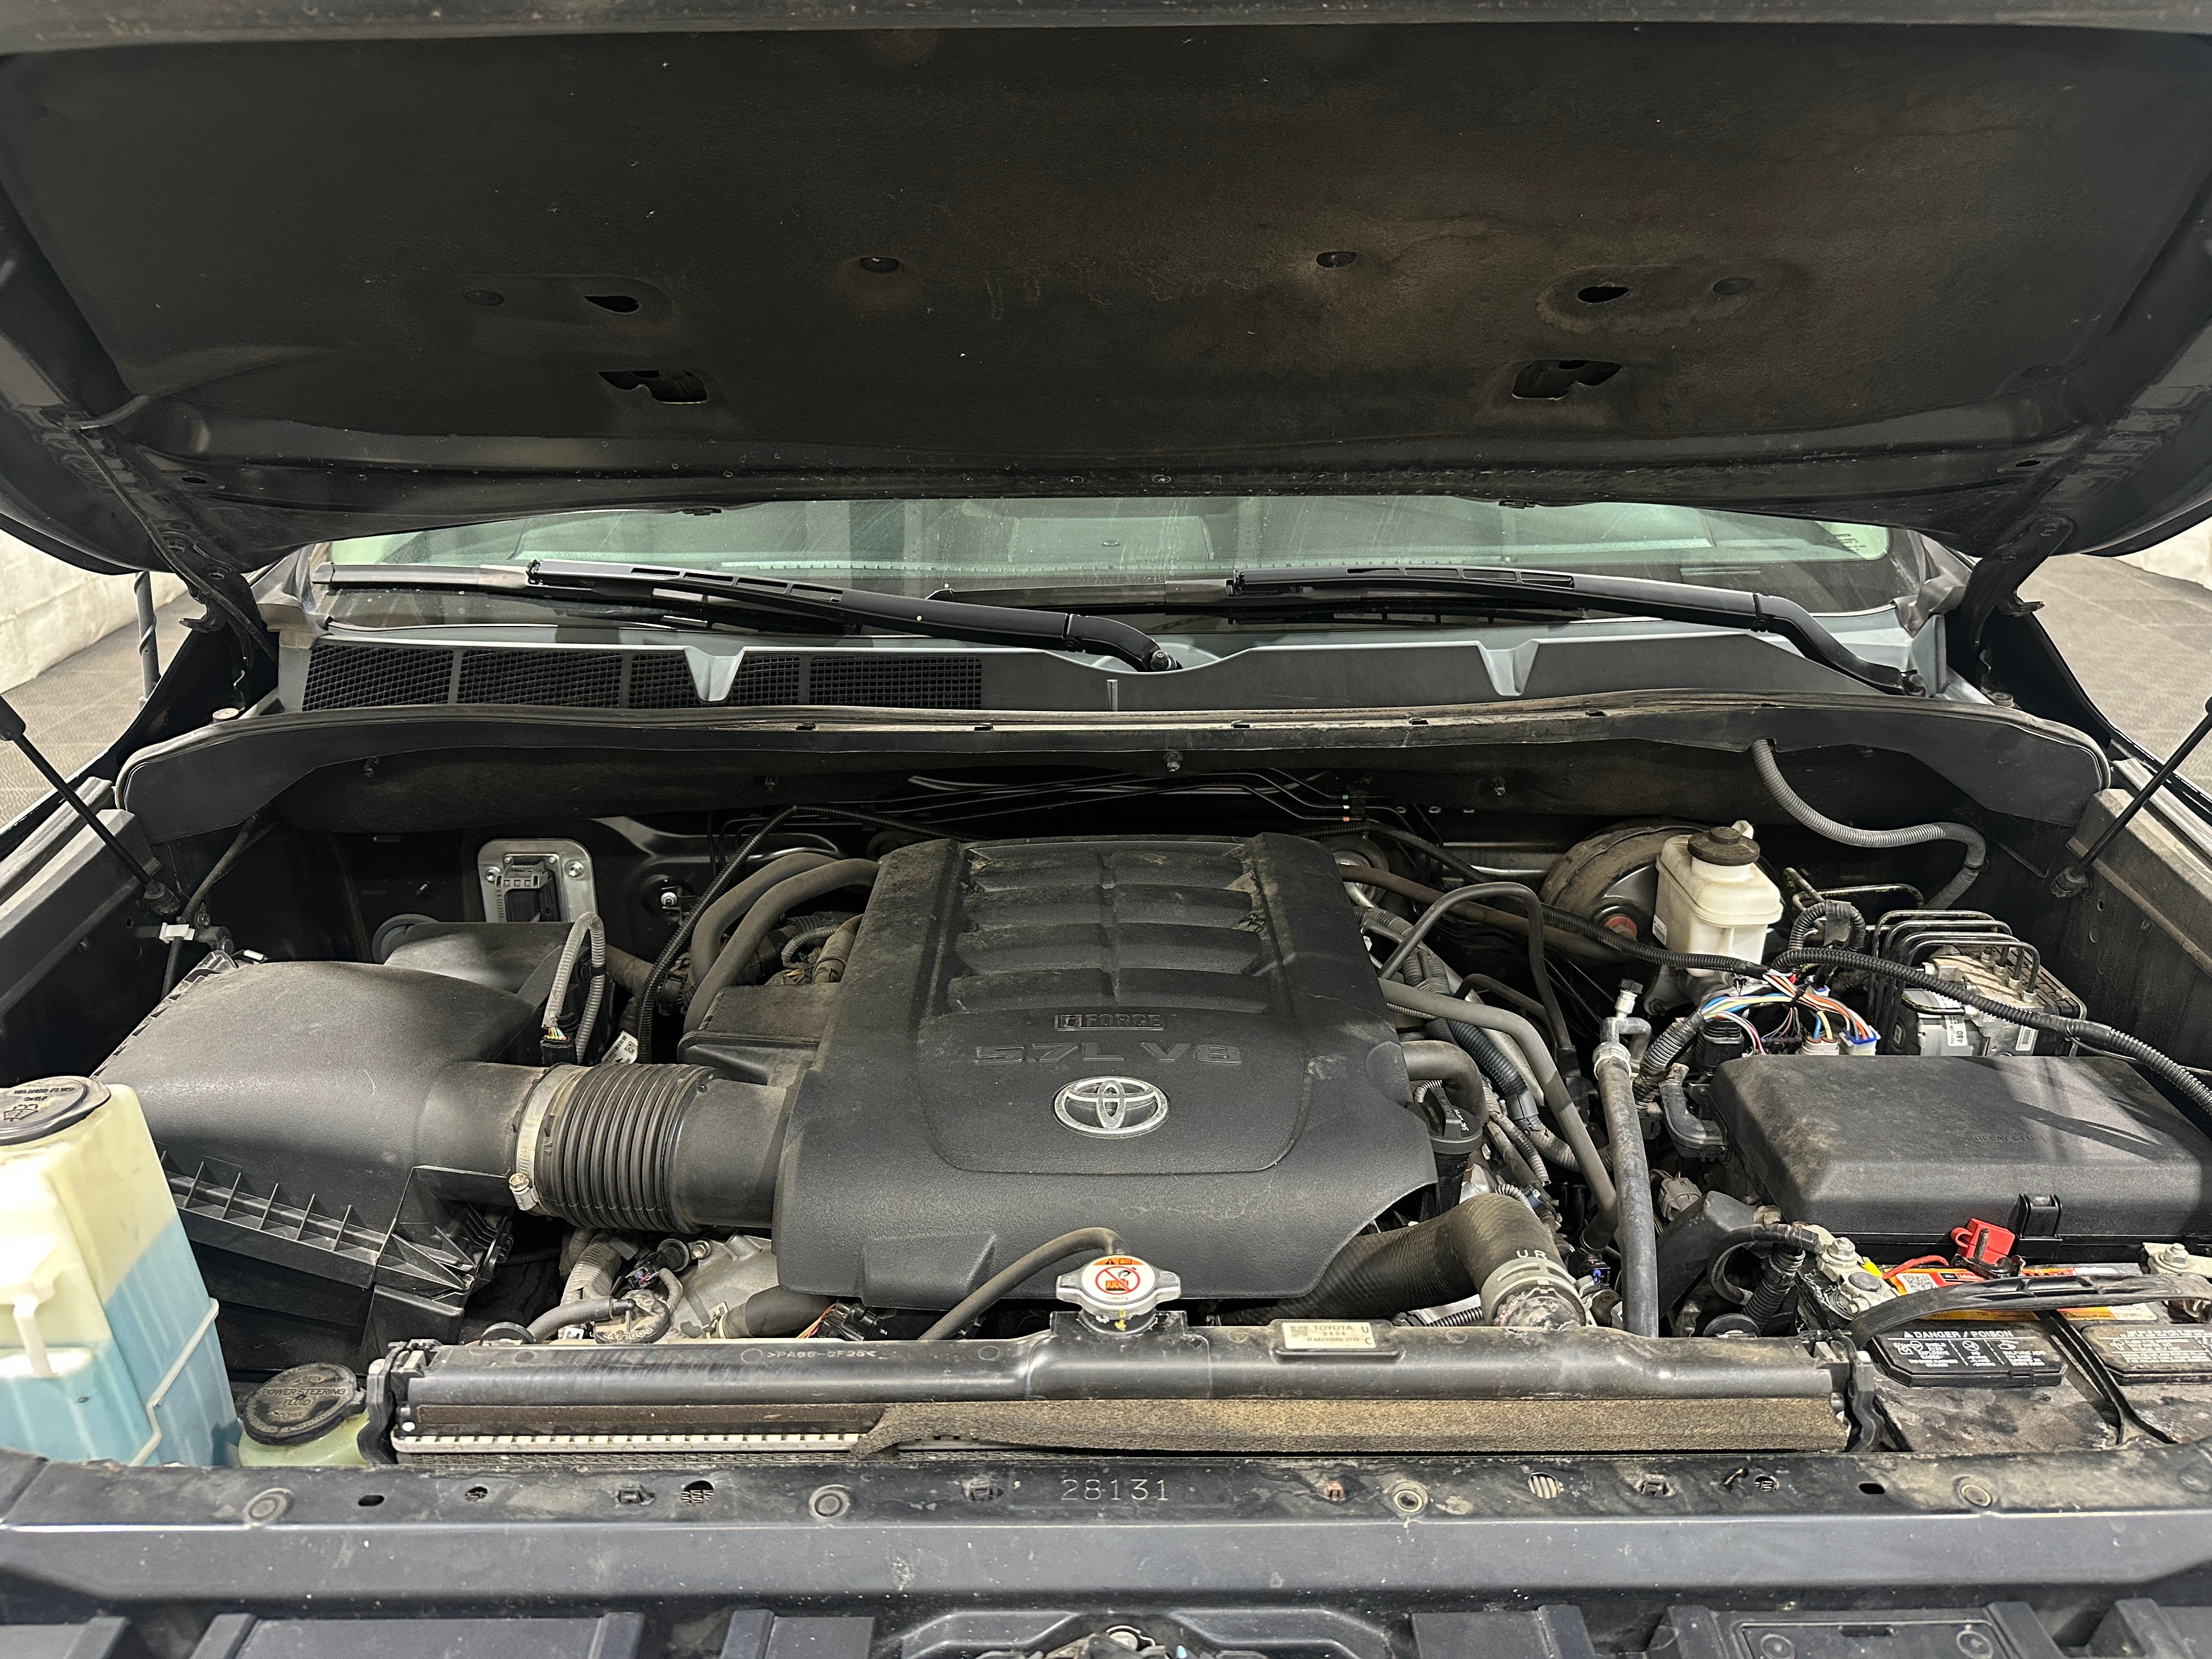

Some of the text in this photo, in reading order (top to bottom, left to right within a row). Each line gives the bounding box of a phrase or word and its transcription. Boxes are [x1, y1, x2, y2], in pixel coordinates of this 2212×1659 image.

[1139, 1042, 1242, 1064] V8
[1361, 1325, 1369, 1334] U
[1060, 1479, 1169, 1500] 28131
